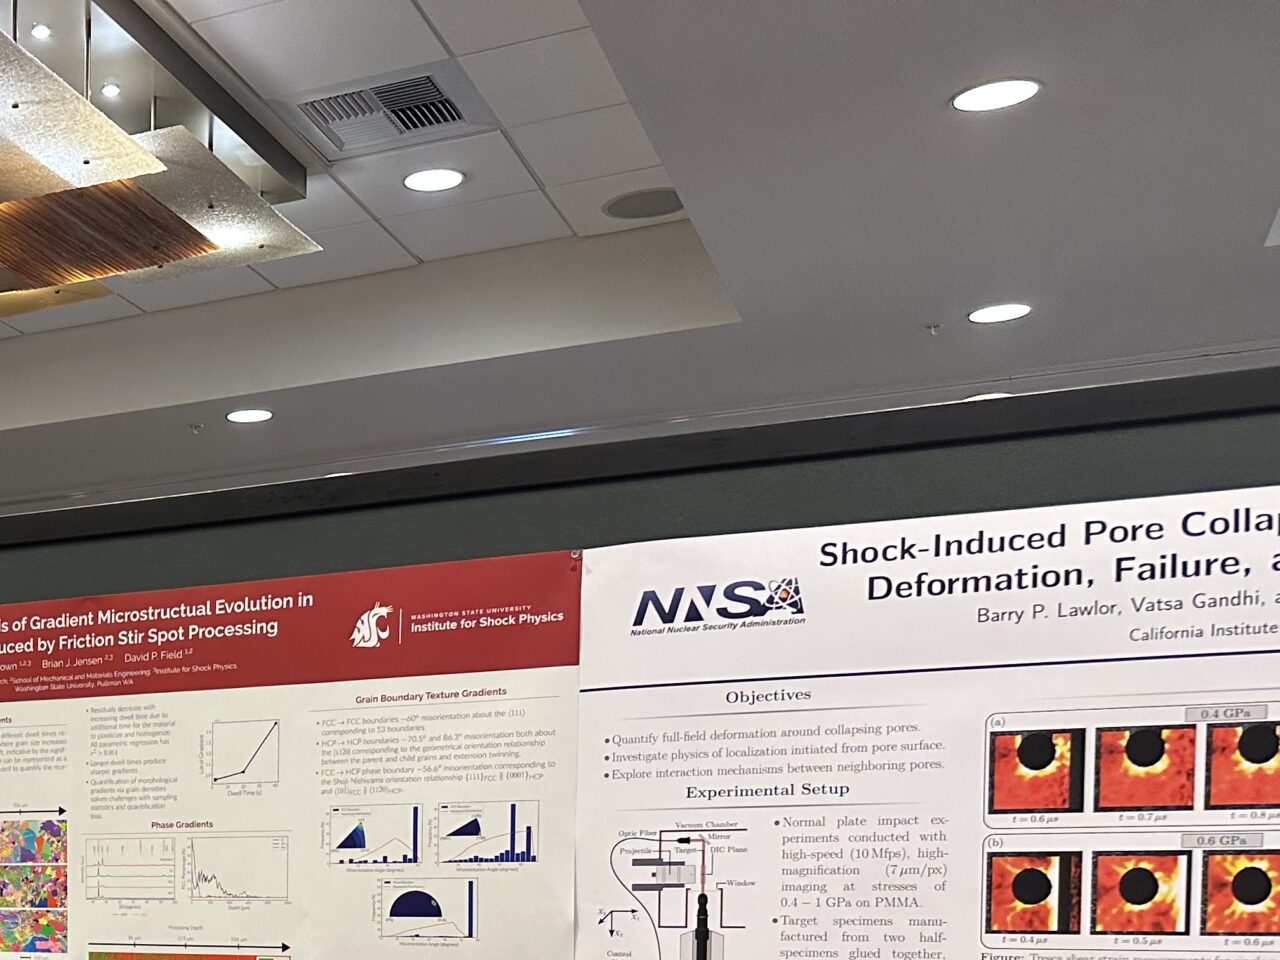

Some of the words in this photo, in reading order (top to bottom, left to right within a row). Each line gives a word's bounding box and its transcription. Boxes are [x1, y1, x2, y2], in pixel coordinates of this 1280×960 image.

[819, 525, 1066, 566] Shock-Induced
[1084, 521, 1164, 544] Pore
[1182, 507, 1280, 537] Colla
[867, 565, 1093, 599] Deformation,
[1114, 555, 1250, 581] Failure,
[11, 616, 27, 631] of
[29, 612, 94, 629] Gradient
[97, 601, 212, 623] Microstructual
[215, 595, 293, 614] Evolution
[297, 591, 313, 607] in
[410, 611, 459, 620] WASHINGTON
[461, 608, 484, 616] STATE
[486, 605, 532, 614] UNIVERSITY
[977, 607, 1025, 624] Barry
[1057, 600, 1122, 617] Lawlor,
[1130, 596, 1184, 612] Vatsa
[1191, 590, 1265, 608] Gandhi,
[410, 617, 458, 632] Institute
[459, 618, 477, 628] for
[479, 614, 516, 627] Shock
[518, 611, 564, 625] Physics
[629, 627, 666, 636] National
[666, 625, 701, 633] Nuclear
[701, 622, 738, 630] Security
[738, 617, 806, 627] Administration
[37, 637, 55, 654] by
[58, 633, 114, 649] Friction
[117, 629, 145, 645] Stir
[147, 626, 184, 645] Spot
[188, 621, 278, 638] Processing
[1128, 625, 1204, 641] California
[1210, 622, 1279, 636] Institute
[41, 659, 64, 668] Brian
[72, 657, 103, 666] Jensen
[123, 651, 150, 662] David
[160, 649, 183, 659] Field
[354, 695, 379, 703] Grain
[379, 693, 424, 702] Boundary
[424, 691, 460, 699] Texture
[461, 687, 507, 697] Gradients
[725, 689, 811, 705] Objectives
[1199, 709, 1219, 719] 0.4
[1222, 707, 1251, 718] GPa
[611, 732, 659, 747] Quantify
[661, 730, 706, 742] full-field
[709, 728, 777, 740] deformation
[780, 726, 821, 737] around
[824, 724, 883, 737] collapsing
[885, 724, 921, 735] pores.
[611, 751, 668, 763] Investigate
[670, 749, 709, 762] physics
[711, 747, 723, 758] of
[725, 746, 787, 757] localization
[790, 744, 838, 755] initiated
[840, 743, 868, 753] from
[871, 743, 898, 754] pore
[899, 740, 945, 751] surface.
[685, 784, 795, 800] Experimental
[800, 783, 850, 797] Setup
[175, 820, 214, 828] Gradients
[782, 815, 826, 827] Normal
[836, 815, 867, 829] plate
[877, 815, 919, 828] impact
[930, 816, 949, 824] ex-
[781, 833, 840, 845] periments
[847, 831, 910, 842] conducted
[918, 830, 947, 841] with
[1196, 836, 1216, 845] 0.6
[1218, 835, 1247, 845] GPa
[781, 848, 844, 861] high-speed
[917, 847, 949, 860] high-
[780, 881, 828, 894] imaging
[842, 882, 855, 891] at
[871, 882, 918, 891] stresses
[933, 879, 947, 891] of
